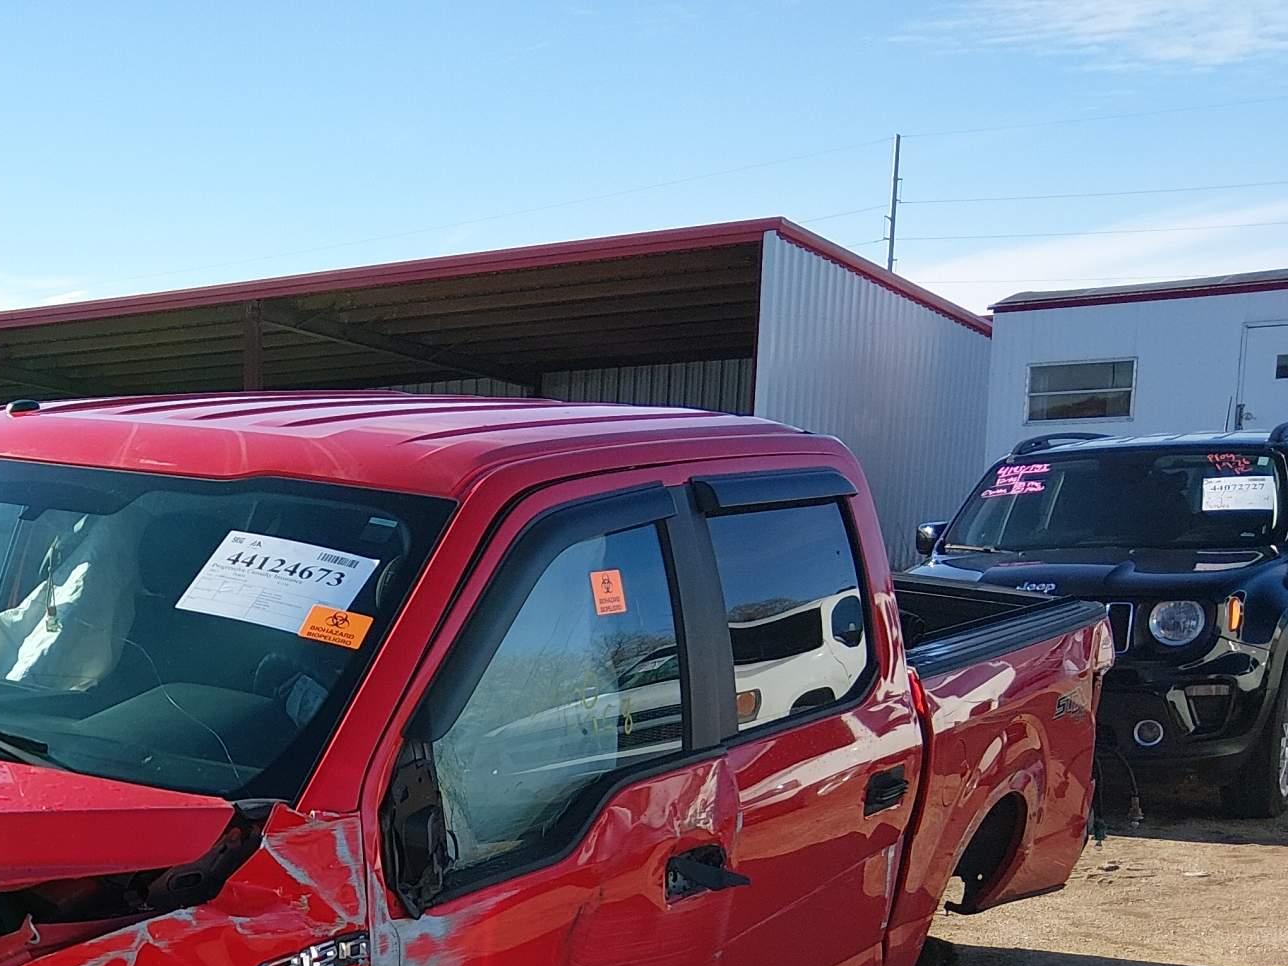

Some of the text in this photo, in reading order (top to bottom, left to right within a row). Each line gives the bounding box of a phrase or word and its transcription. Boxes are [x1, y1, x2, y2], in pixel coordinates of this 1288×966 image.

[227, 551, 346, 587] 44124673
[1016, 582, 1056, 593] Jeep
[306, 631, 353, 647] BIOPELIGRO
[310, 625, 355, 640] BIOHAZARD
